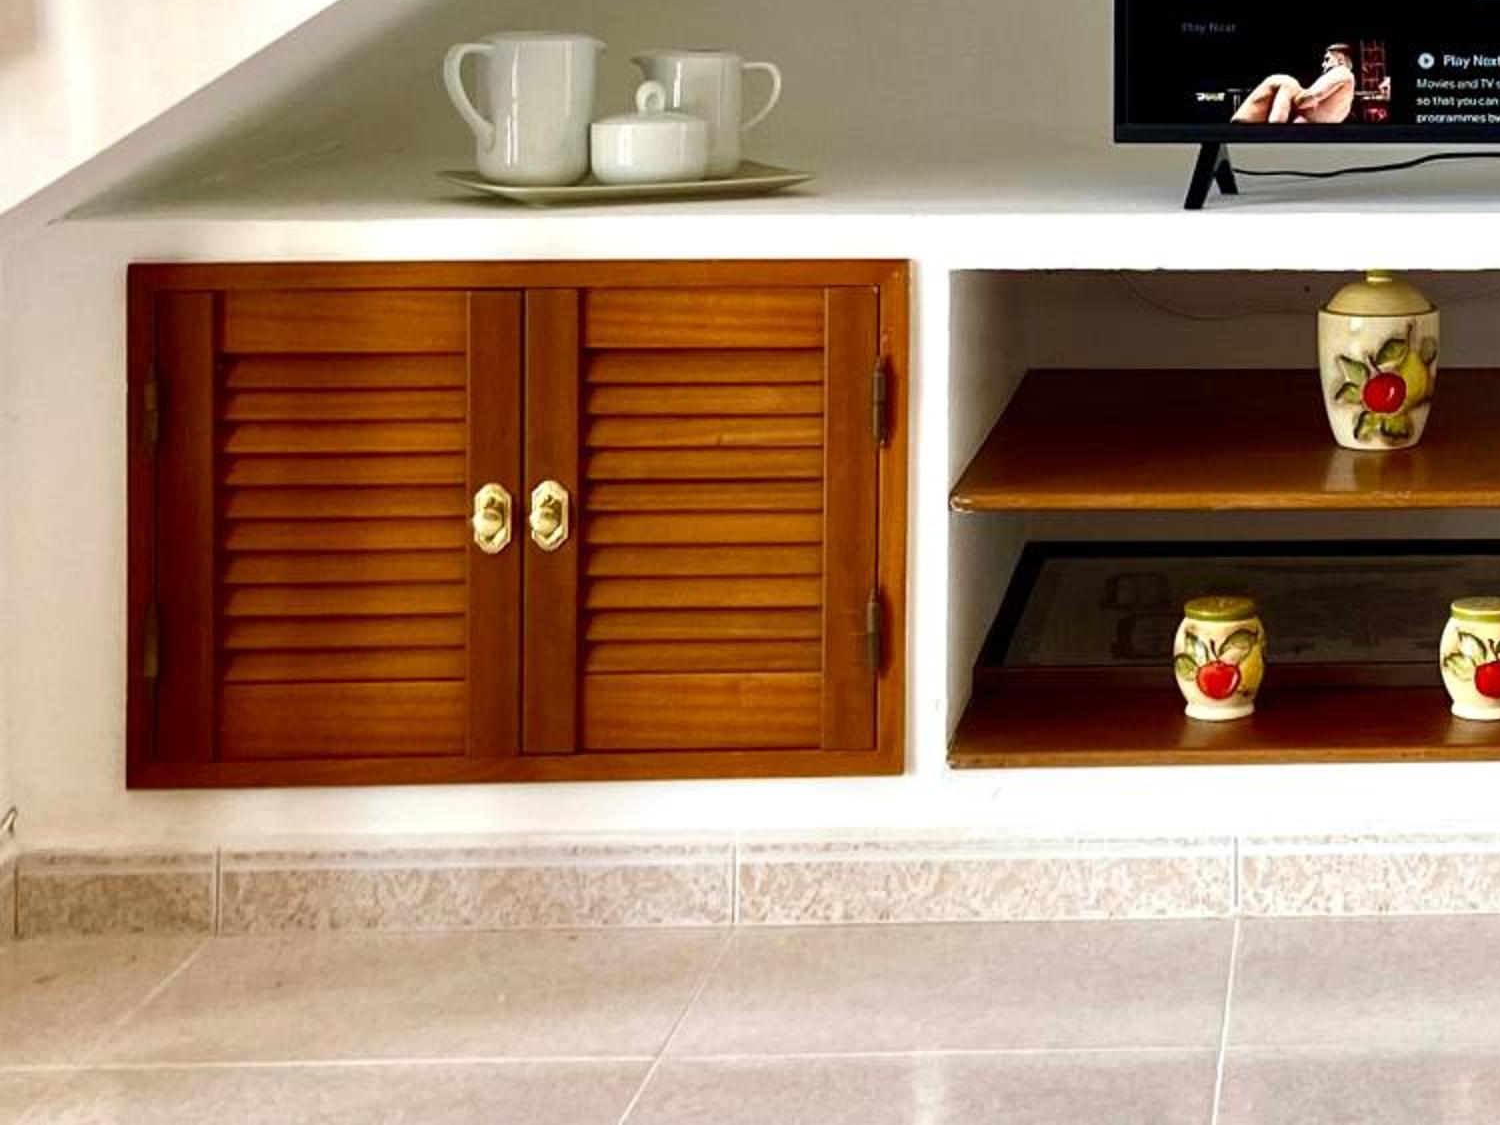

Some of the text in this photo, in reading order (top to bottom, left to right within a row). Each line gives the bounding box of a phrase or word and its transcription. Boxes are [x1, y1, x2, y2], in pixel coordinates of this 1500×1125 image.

[1443, 54, 1470, 69] Play
[1416, 78, 1456, 89] Movies
[1457, 79, 1479, 90] and
[1481, 79, 1495, 89] TV
[1416, 97, 1430, 106] so
[1432, 96, 1455, 106] that
[1457, 98, 1477, 108] you
[1478, 97, 1499, 107] can
